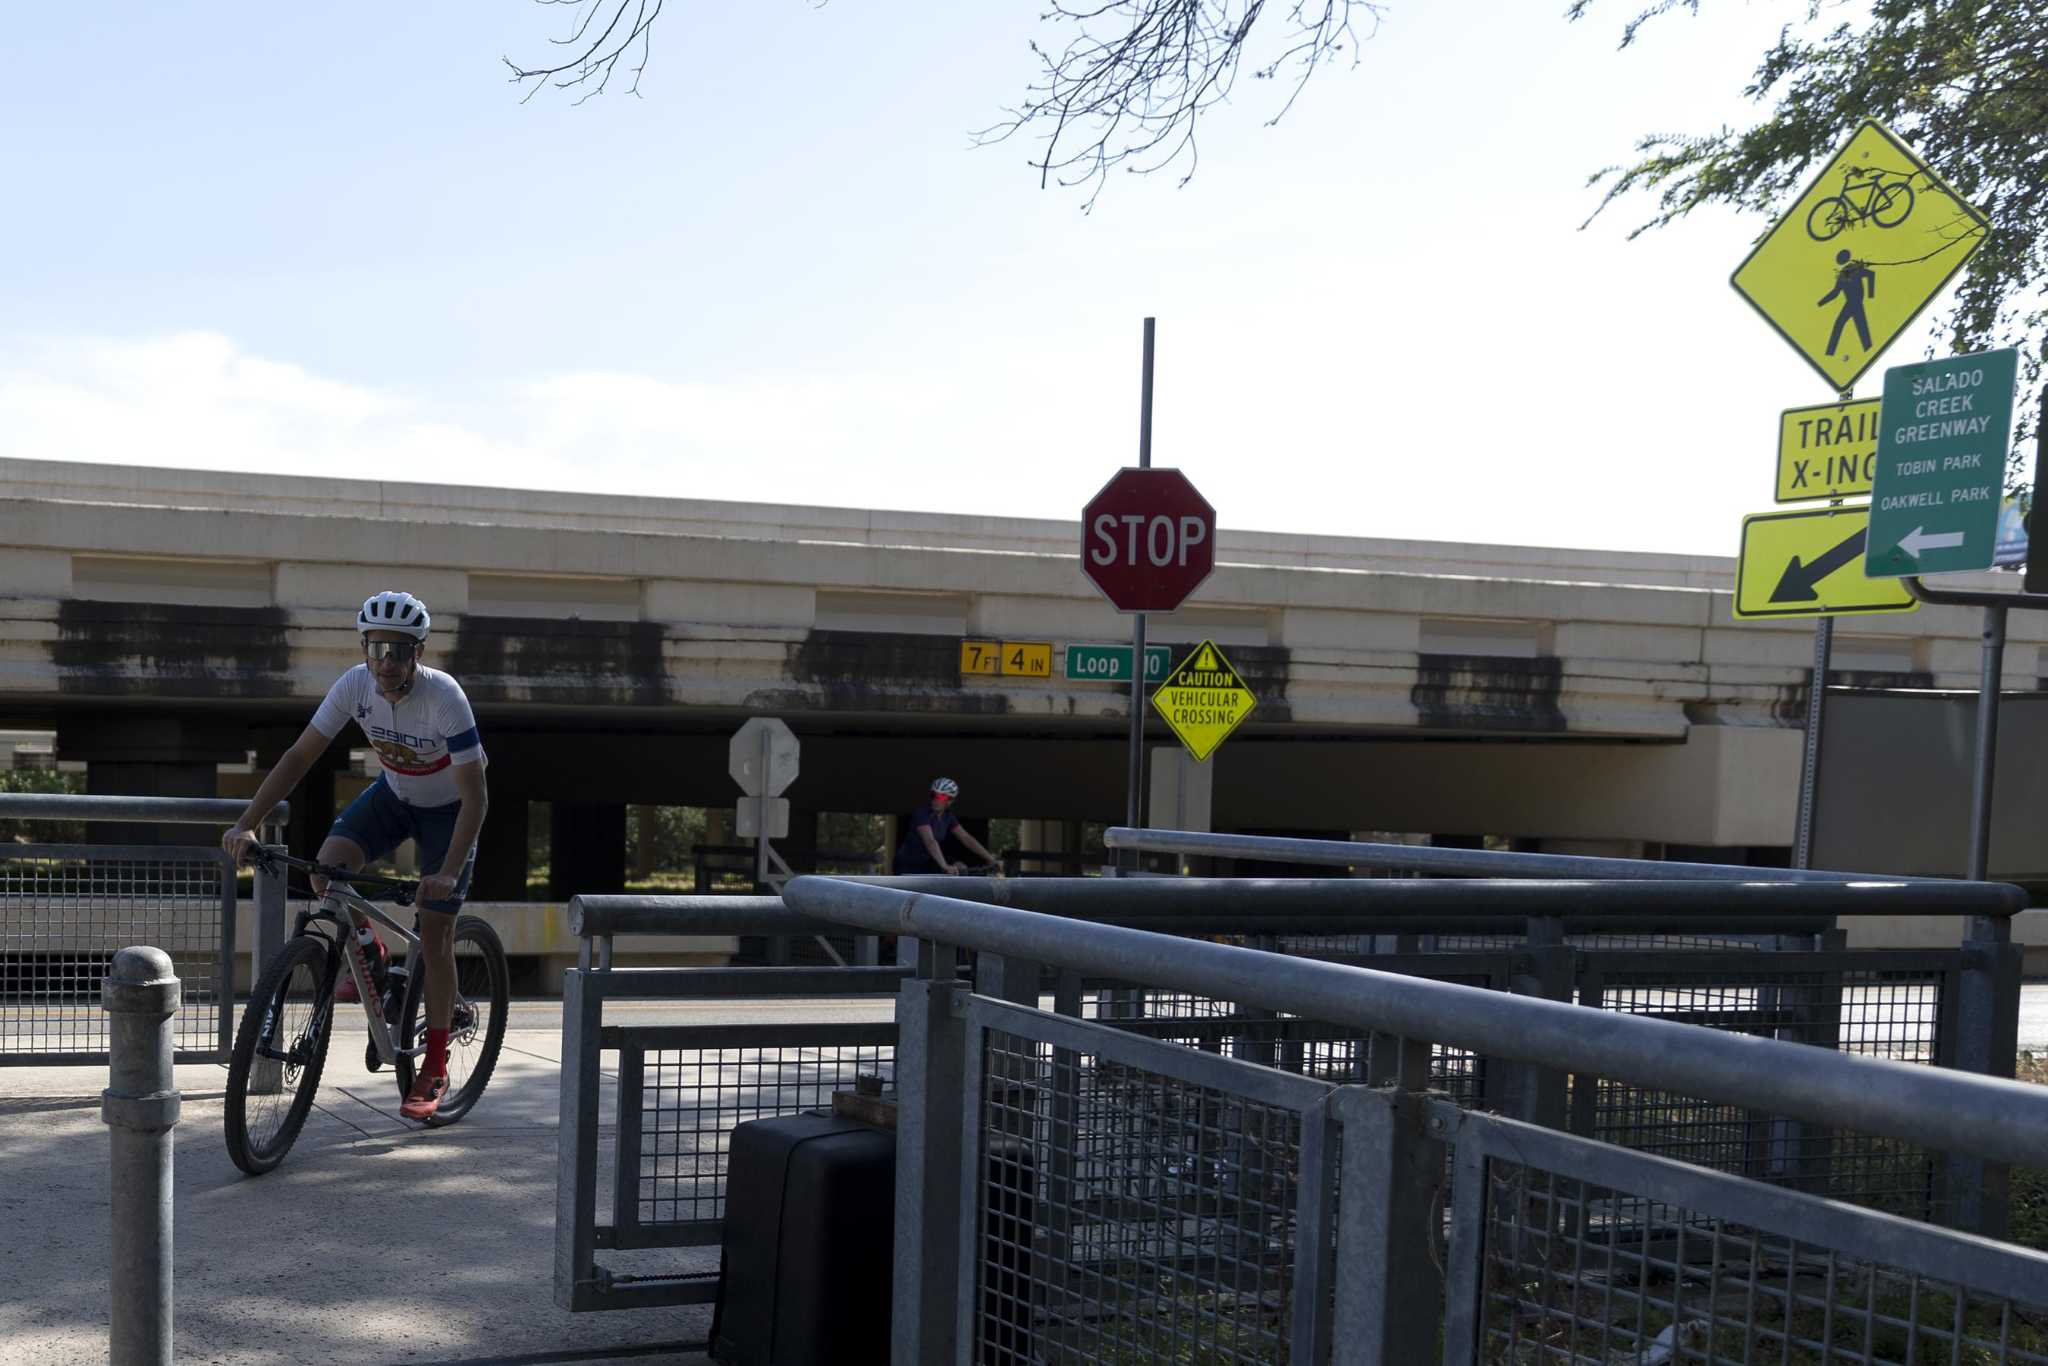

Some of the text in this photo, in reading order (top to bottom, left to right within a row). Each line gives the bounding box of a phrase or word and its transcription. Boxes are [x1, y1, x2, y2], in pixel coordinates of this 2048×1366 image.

[1912, 369, 1984, 396] SALADO
[1915, 393, 1974, 418] CREEK
[1798, 411, 1878, 449] TRAIL
[1895, 415, 1991, 444] GREENWAY
[1896, 453, 1982, 477] TOBIN PARK
[1880, 485, 1990, 511] OAKWELL PARK
[1091, 514, 1206, 567] STOP
[968, 647, 1044, 672] 7 FT 4 IN
[1076, 652, 1161, 677] Loop 10
[1178, 671, 1233, 687] CAUTION
[1171, 691, 1239, 707] VEHICULAR
[1173, 709, 1234, 725] CROSSING
